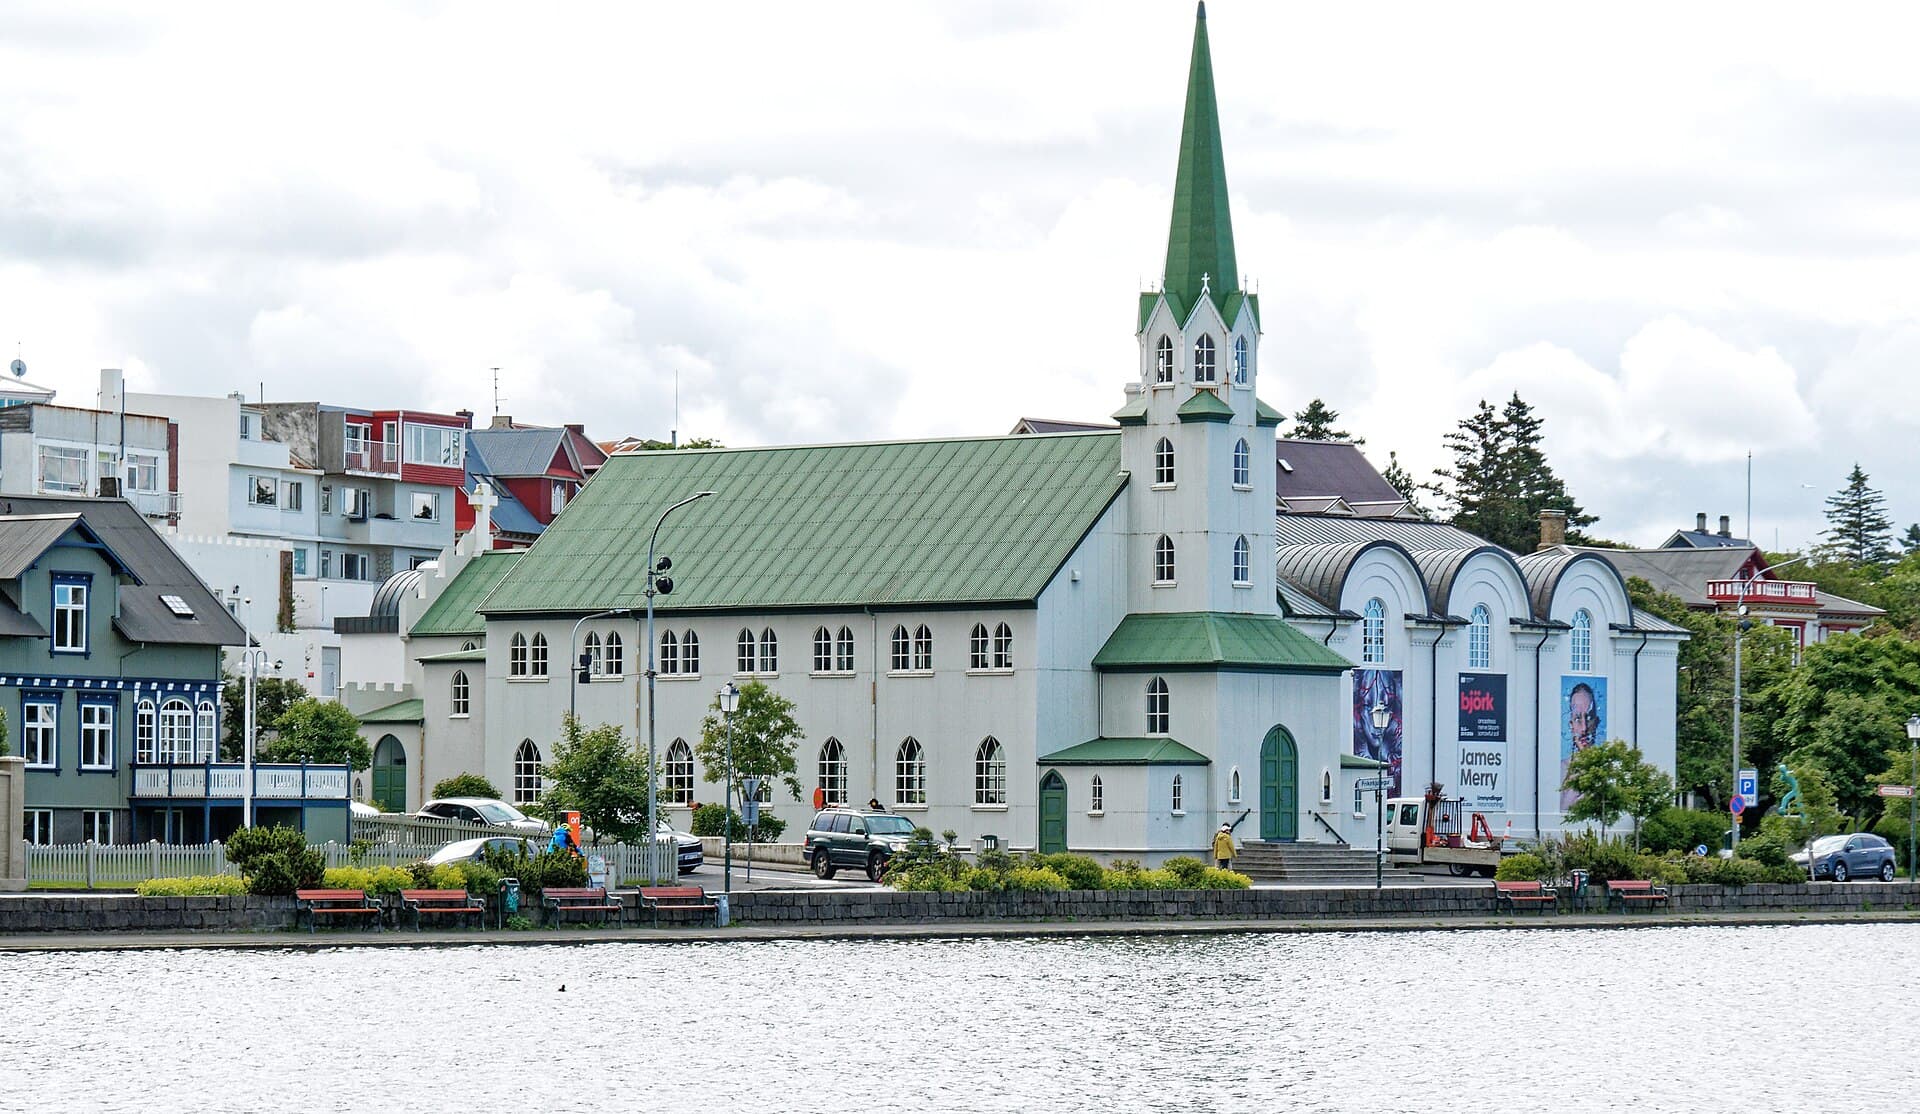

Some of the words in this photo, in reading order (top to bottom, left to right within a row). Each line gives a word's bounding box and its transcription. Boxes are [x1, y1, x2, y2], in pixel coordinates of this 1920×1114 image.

[1460, 690, 1494, 714] björk
[1460, 748, 1502, 766] James
[1460, 768, 1498, 791] Merry
[1744, 781, 1752, 792] P
